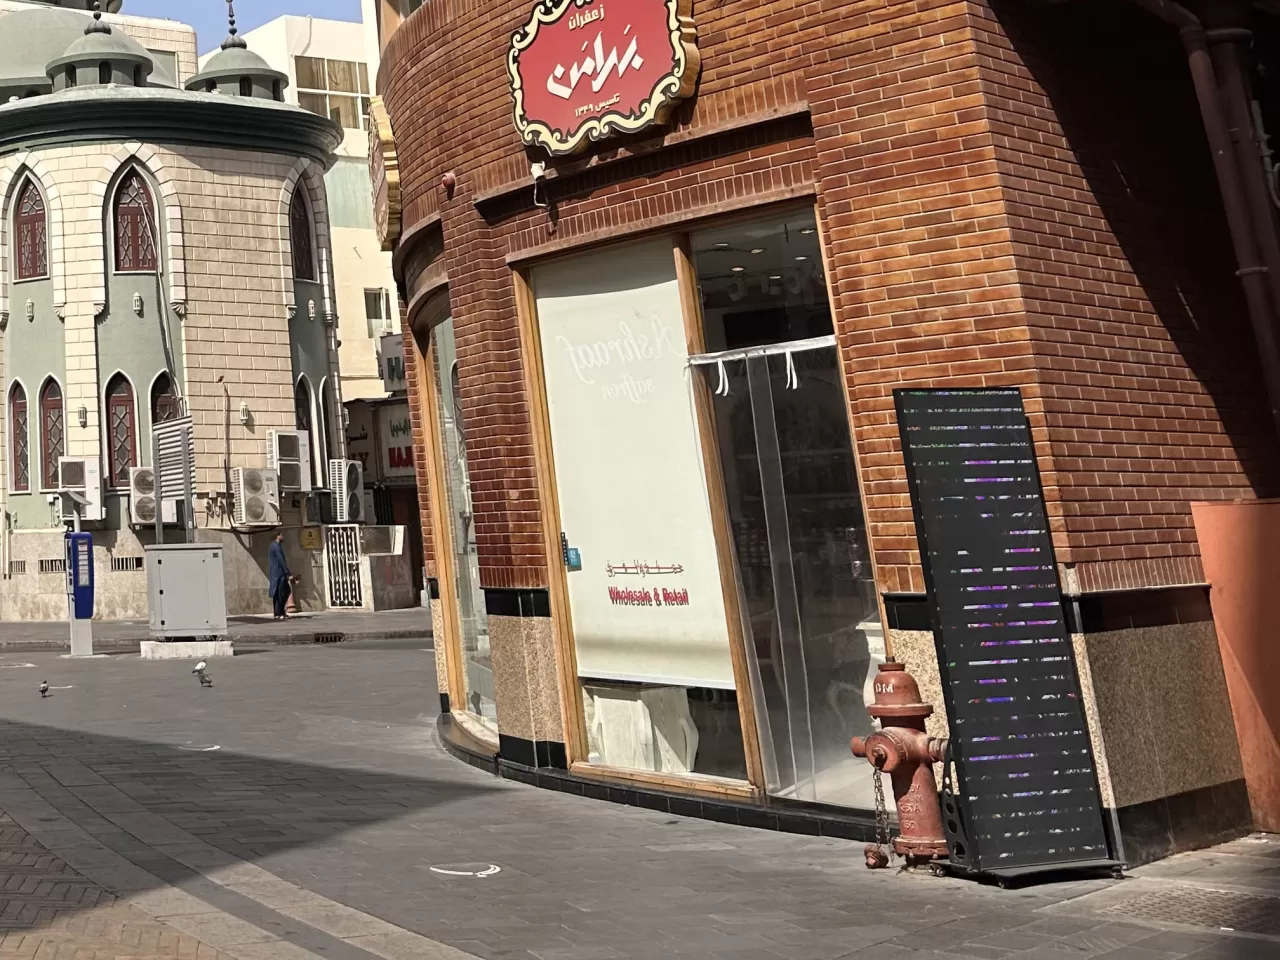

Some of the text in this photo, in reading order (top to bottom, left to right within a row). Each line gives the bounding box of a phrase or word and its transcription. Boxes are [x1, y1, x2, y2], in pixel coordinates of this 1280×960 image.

[568, 4, 605, 30] زعفران
[608, 586, 689, 607] Wholesale & Retail
